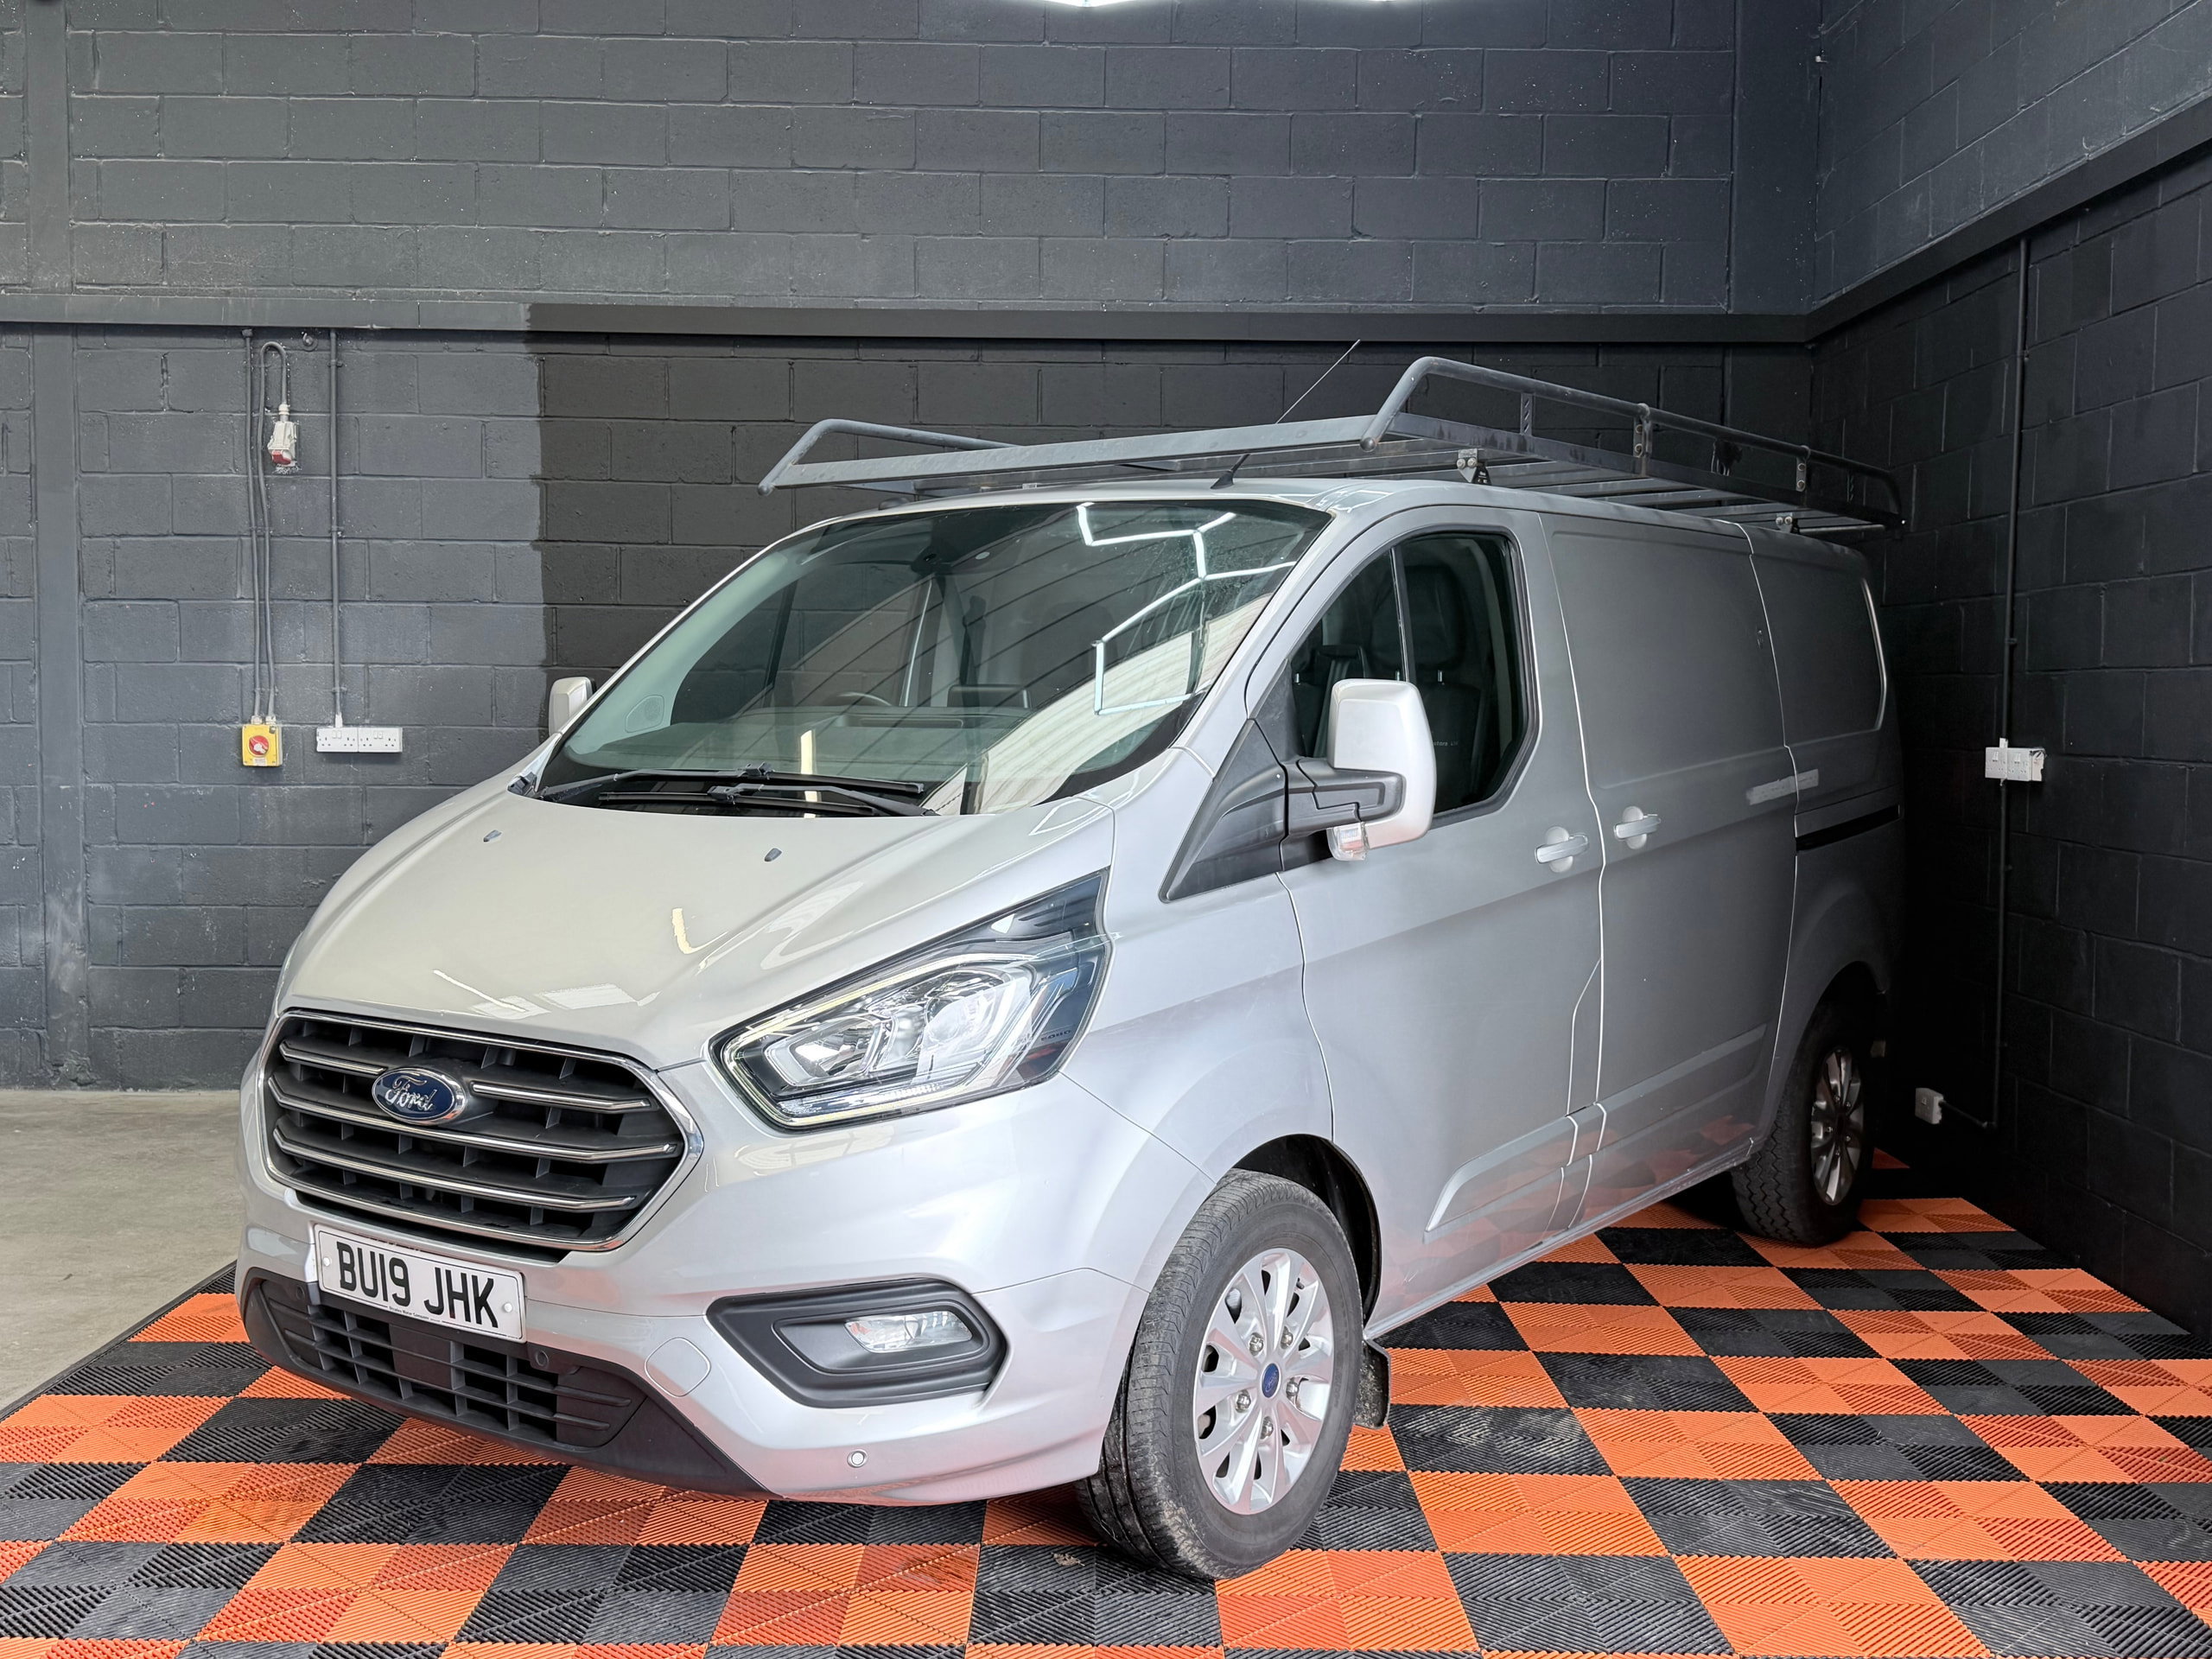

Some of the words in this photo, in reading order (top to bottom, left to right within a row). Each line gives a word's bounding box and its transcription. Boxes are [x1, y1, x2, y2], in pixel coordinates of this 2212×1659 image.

[385, 1075, 438, 1111] Ford
[336, 1241, 411, 1307] BU19
[423, 1267, 499, 1329] JHK
